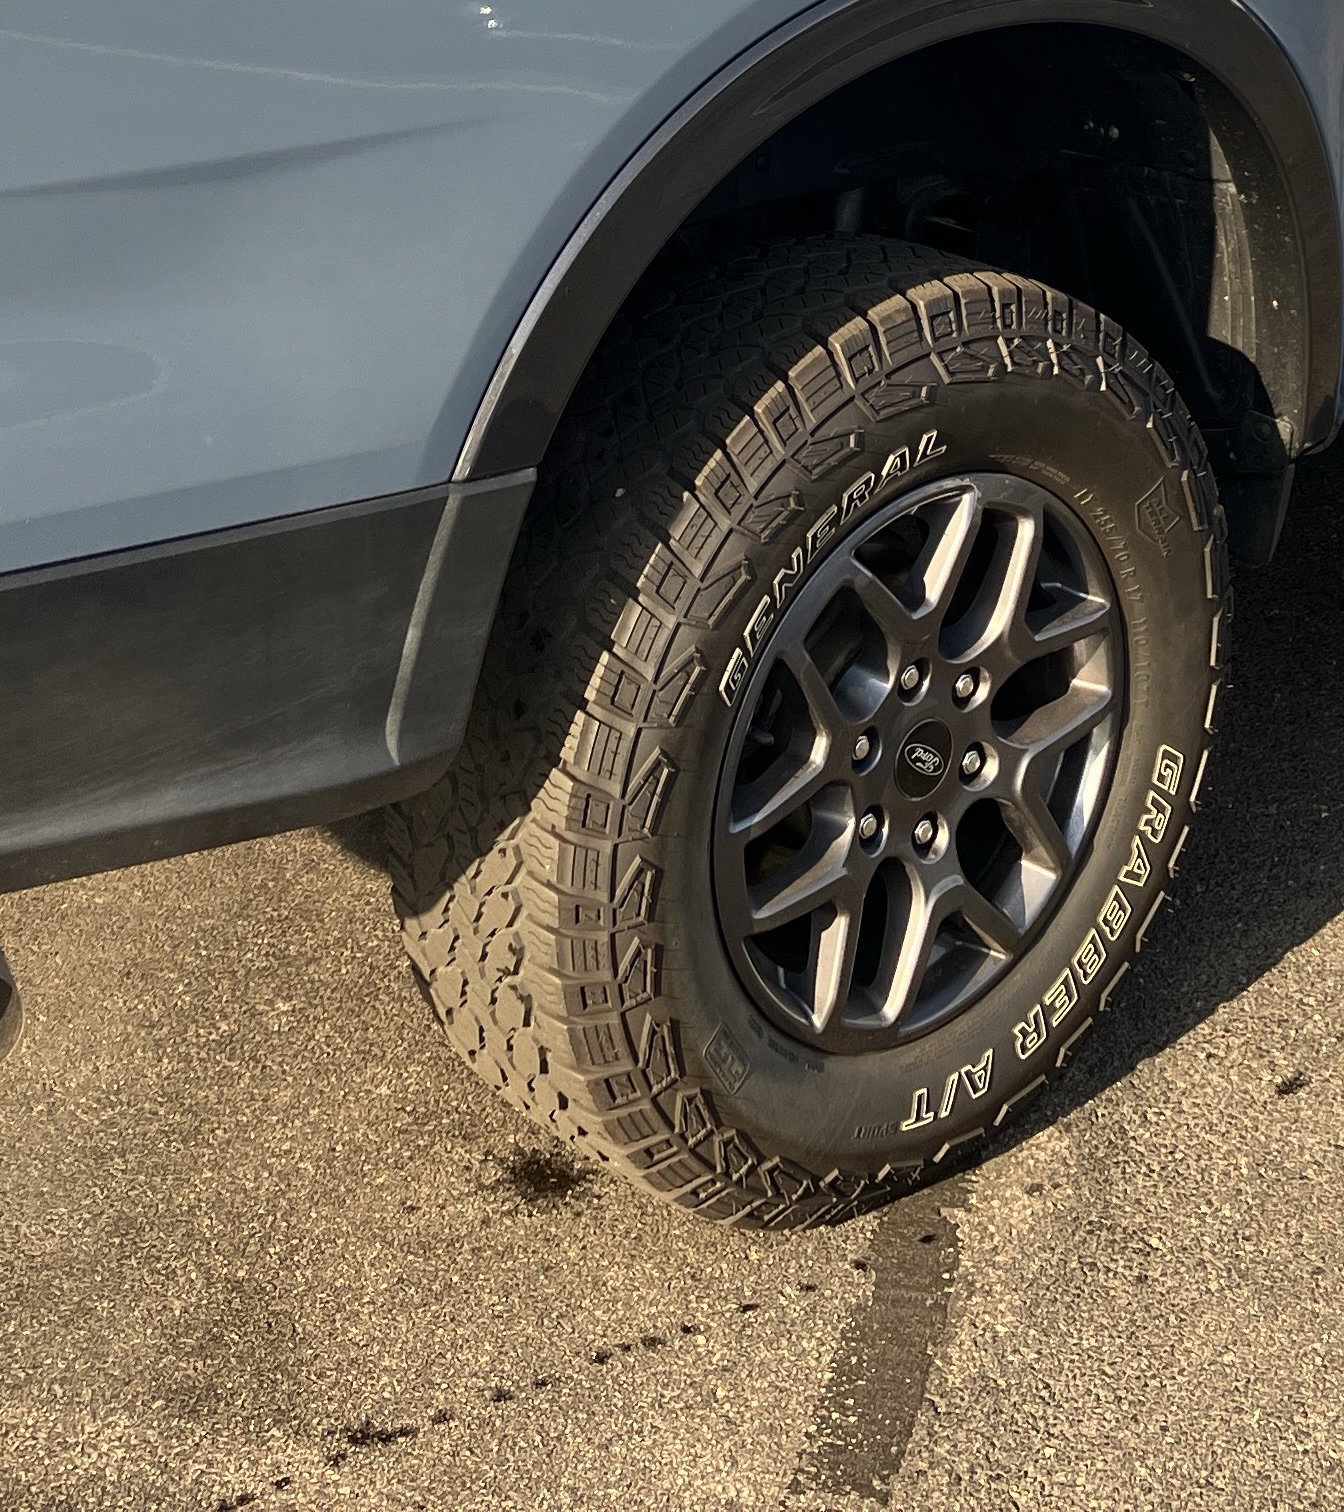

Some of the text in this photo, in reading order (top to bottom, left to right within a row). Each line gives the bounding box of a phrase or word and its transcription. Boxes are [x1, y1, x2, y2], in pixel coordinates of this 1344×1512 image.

[718, 429, 948, 708] GENERAL
[910, 746, 940, 773] Ford
[1012, 743, 1185, 1061] GRABBER
[900, 1048, 994, 1131] A/T
